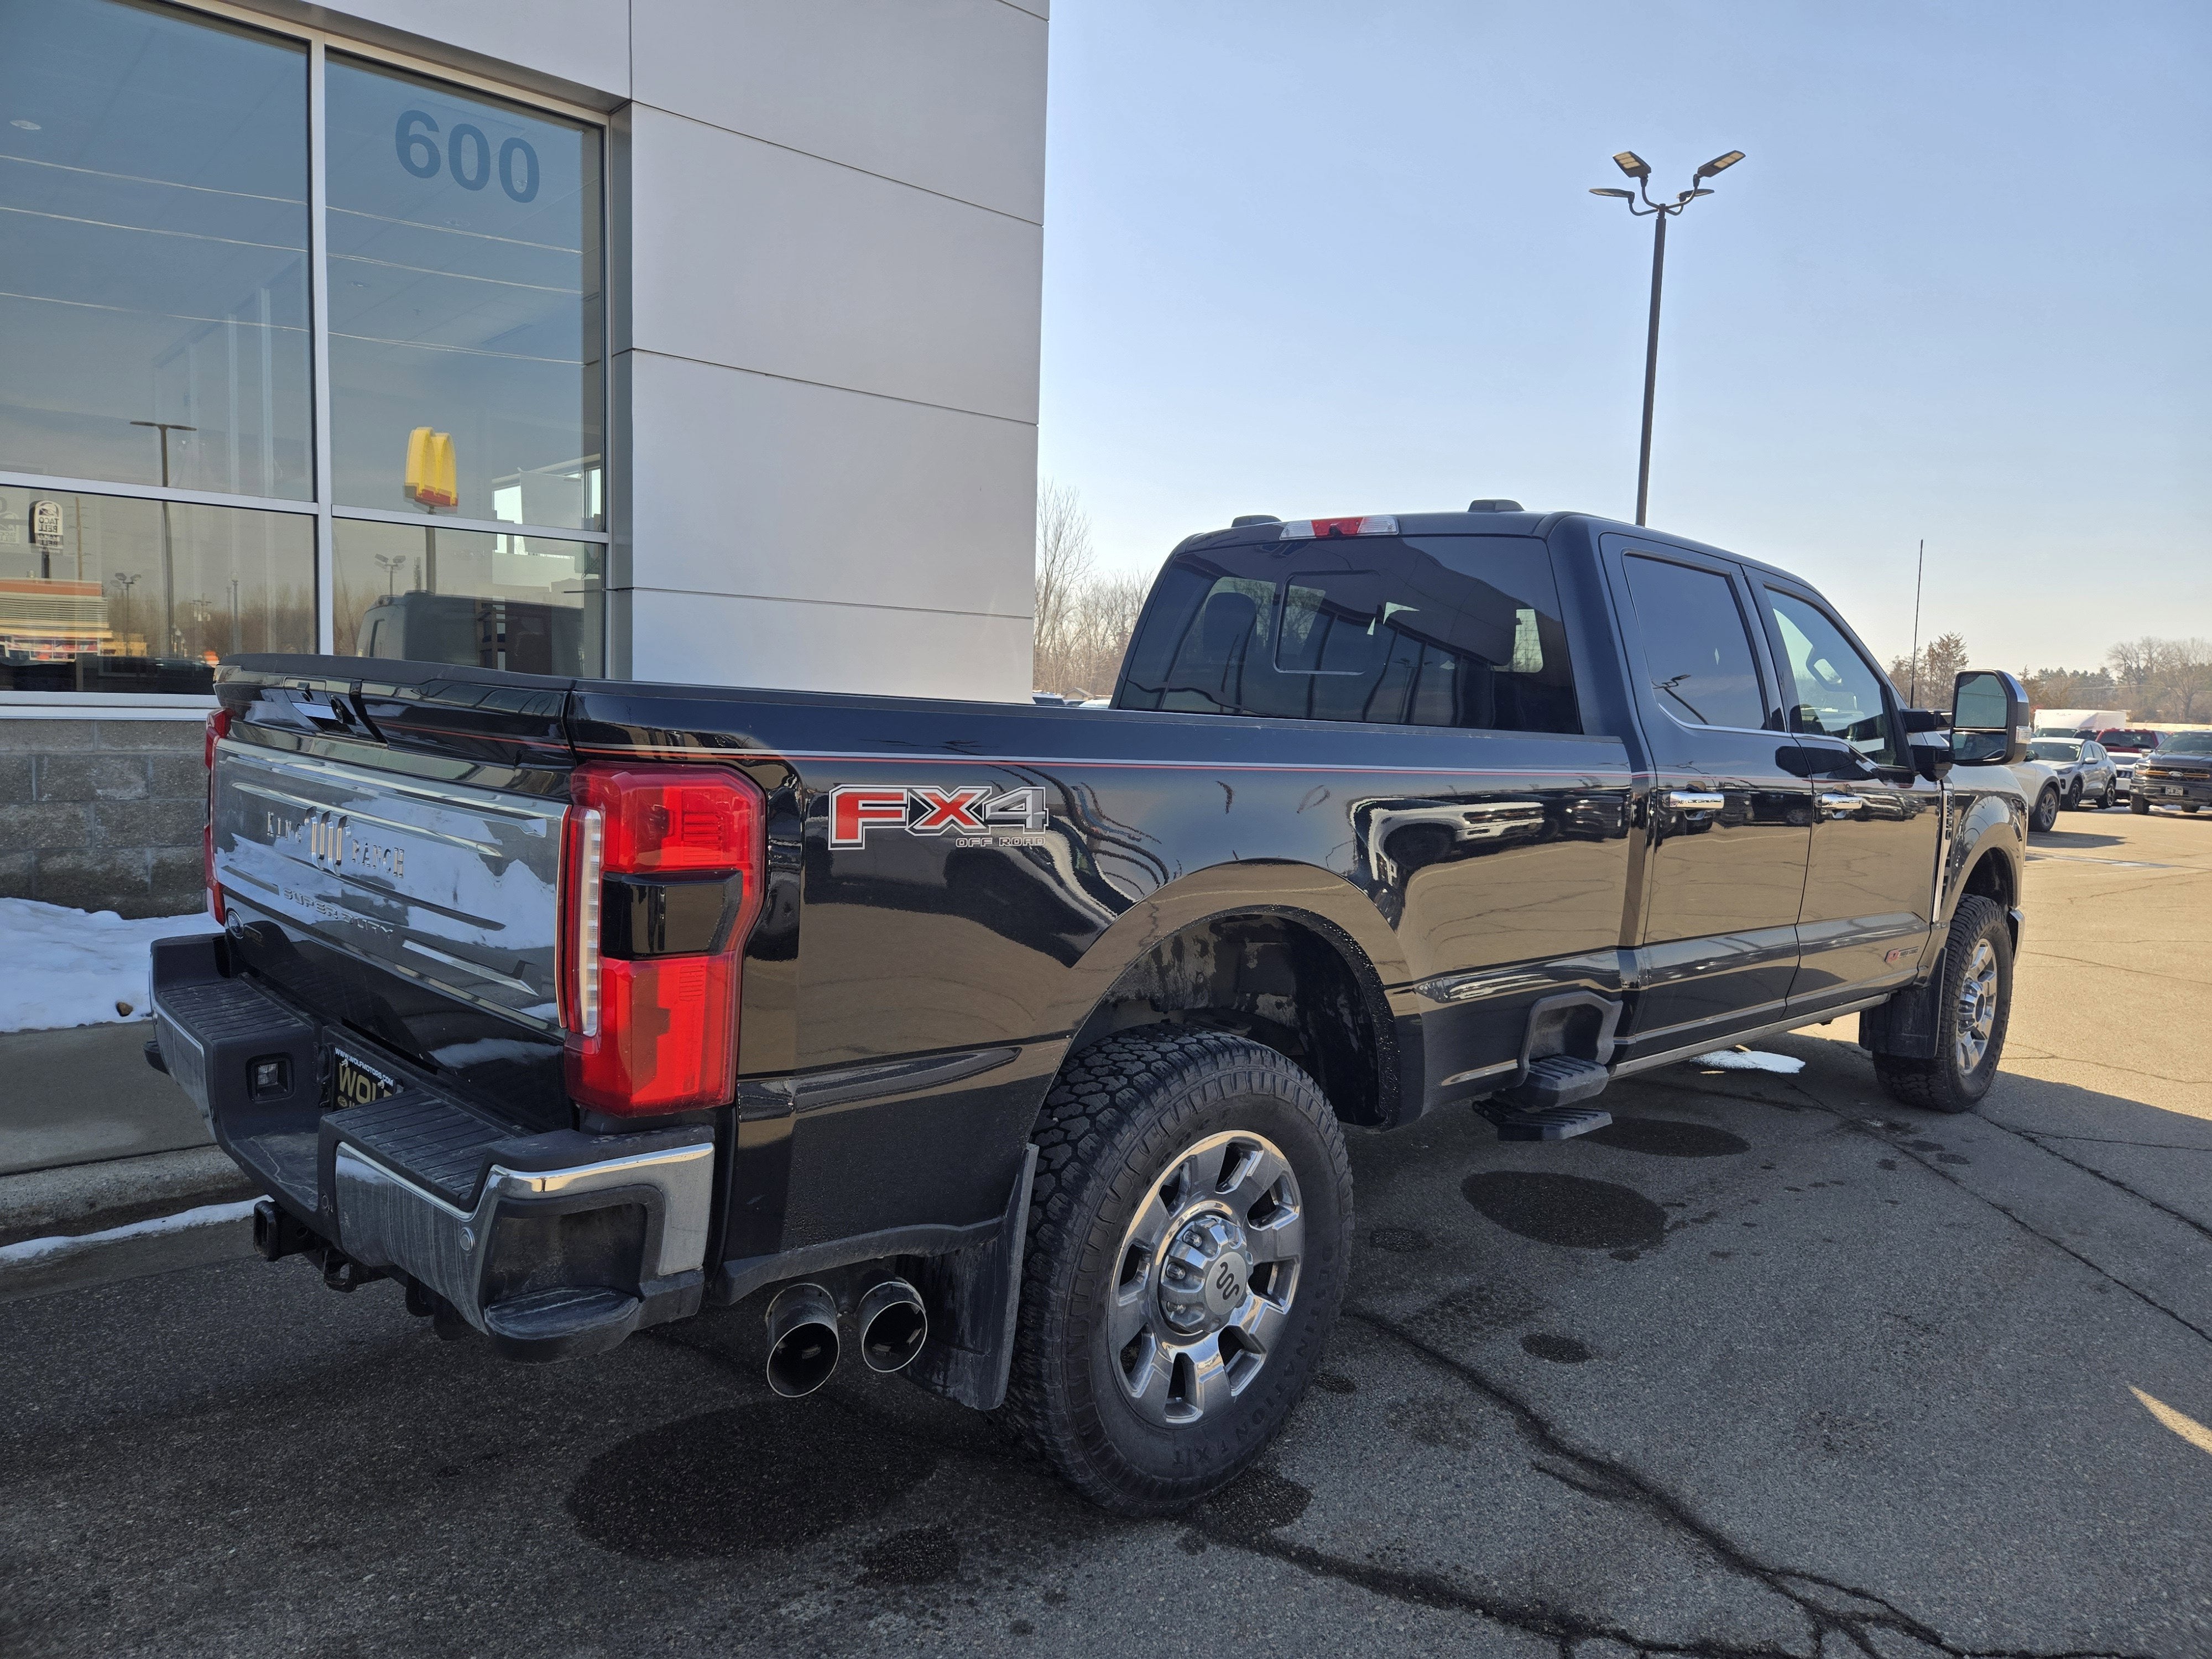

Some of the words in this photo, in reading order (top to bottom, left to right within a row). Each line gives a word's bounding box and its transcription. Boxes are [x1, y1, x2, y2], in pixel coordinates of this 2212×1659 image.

[395, 109, 540, 204] 600
[828, 784, 1048, 850] FX4
[955, 836, 993, 848] OFF
[999, 836, 1046, 847] ROAD
[267, 811, 302, 844] KING
[351, 838, 404, 878] RANCH
[283, 886, 339, 919] SUPER
[341, 911, 394, 940] DUTY
[335, 1047, 394, 1087] WWW.WOLFMOTORS.COM
[339, 1062, 393, 1104] WOL
